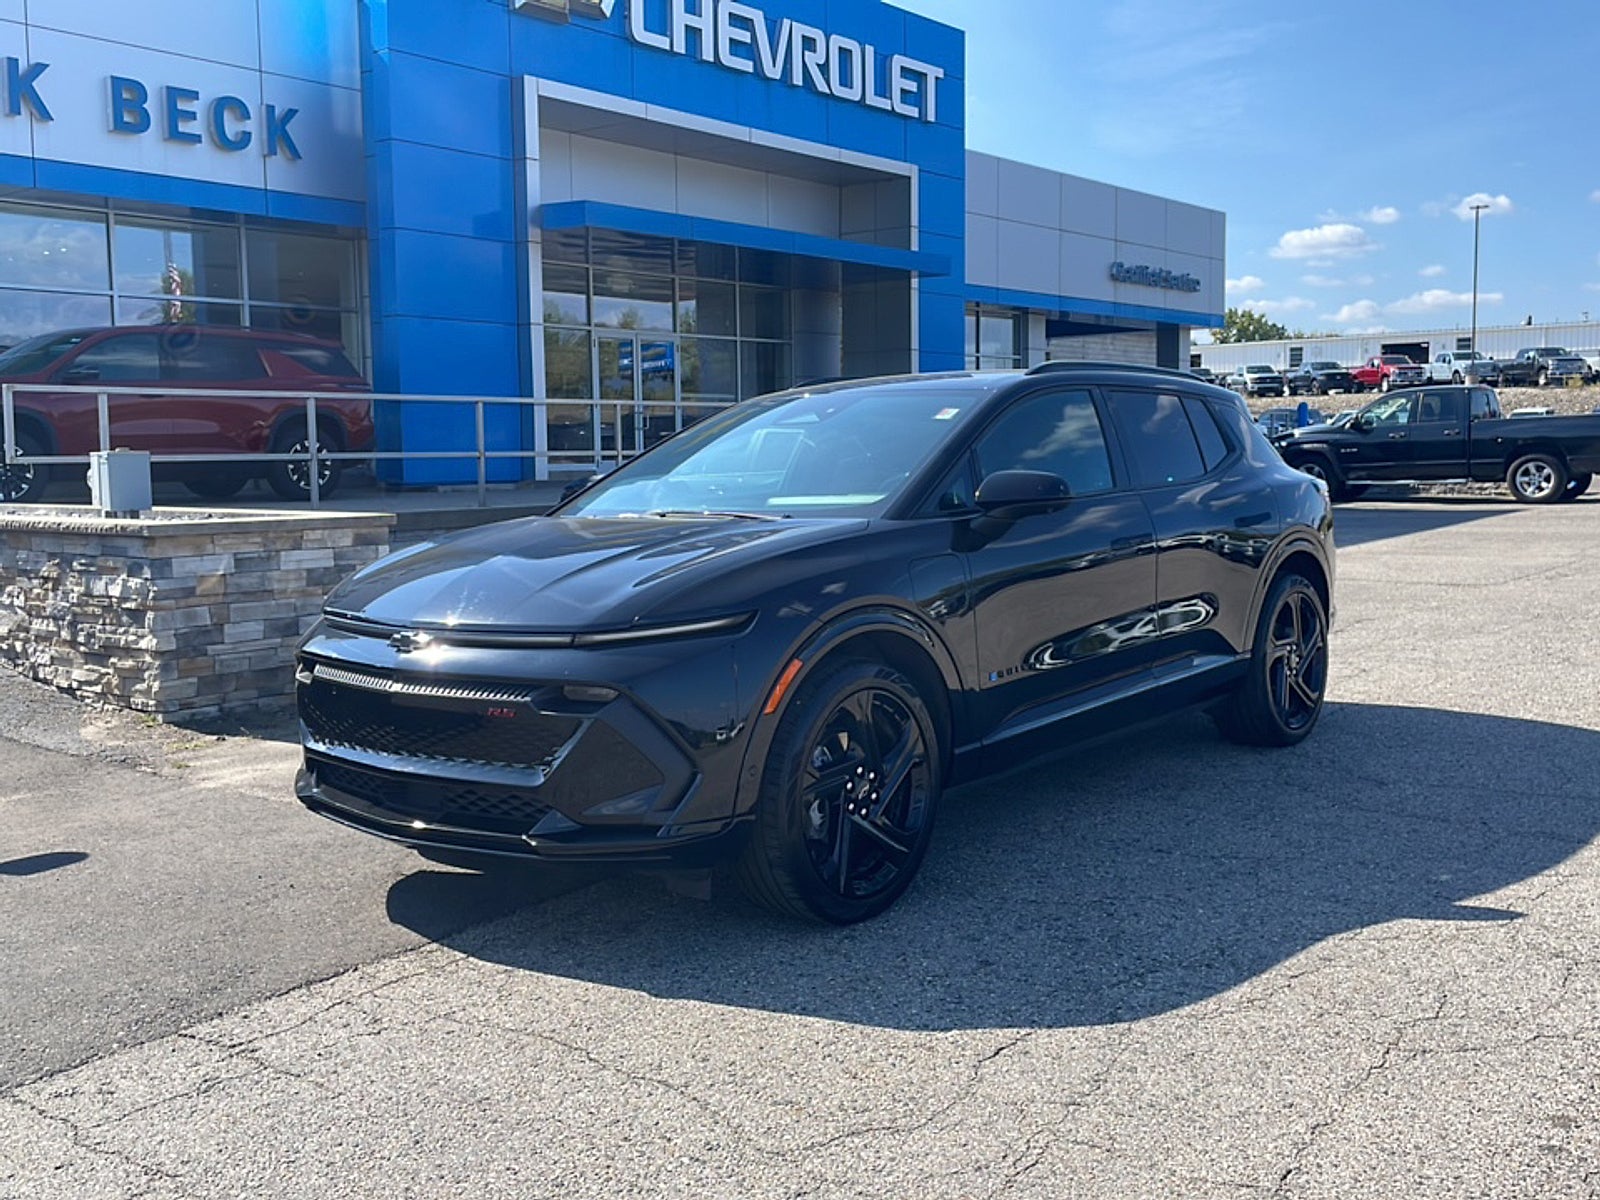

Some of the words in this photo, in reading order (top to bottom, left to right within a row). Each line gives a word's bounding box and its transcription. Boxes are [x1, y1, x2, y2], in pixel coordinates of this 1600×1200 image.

[2, 56, 54, 121] K
[105, 75, 302, 159] BECK
[628, 0, 944, 122] CHEVROLET
[487, 707, 517, 718] RS
